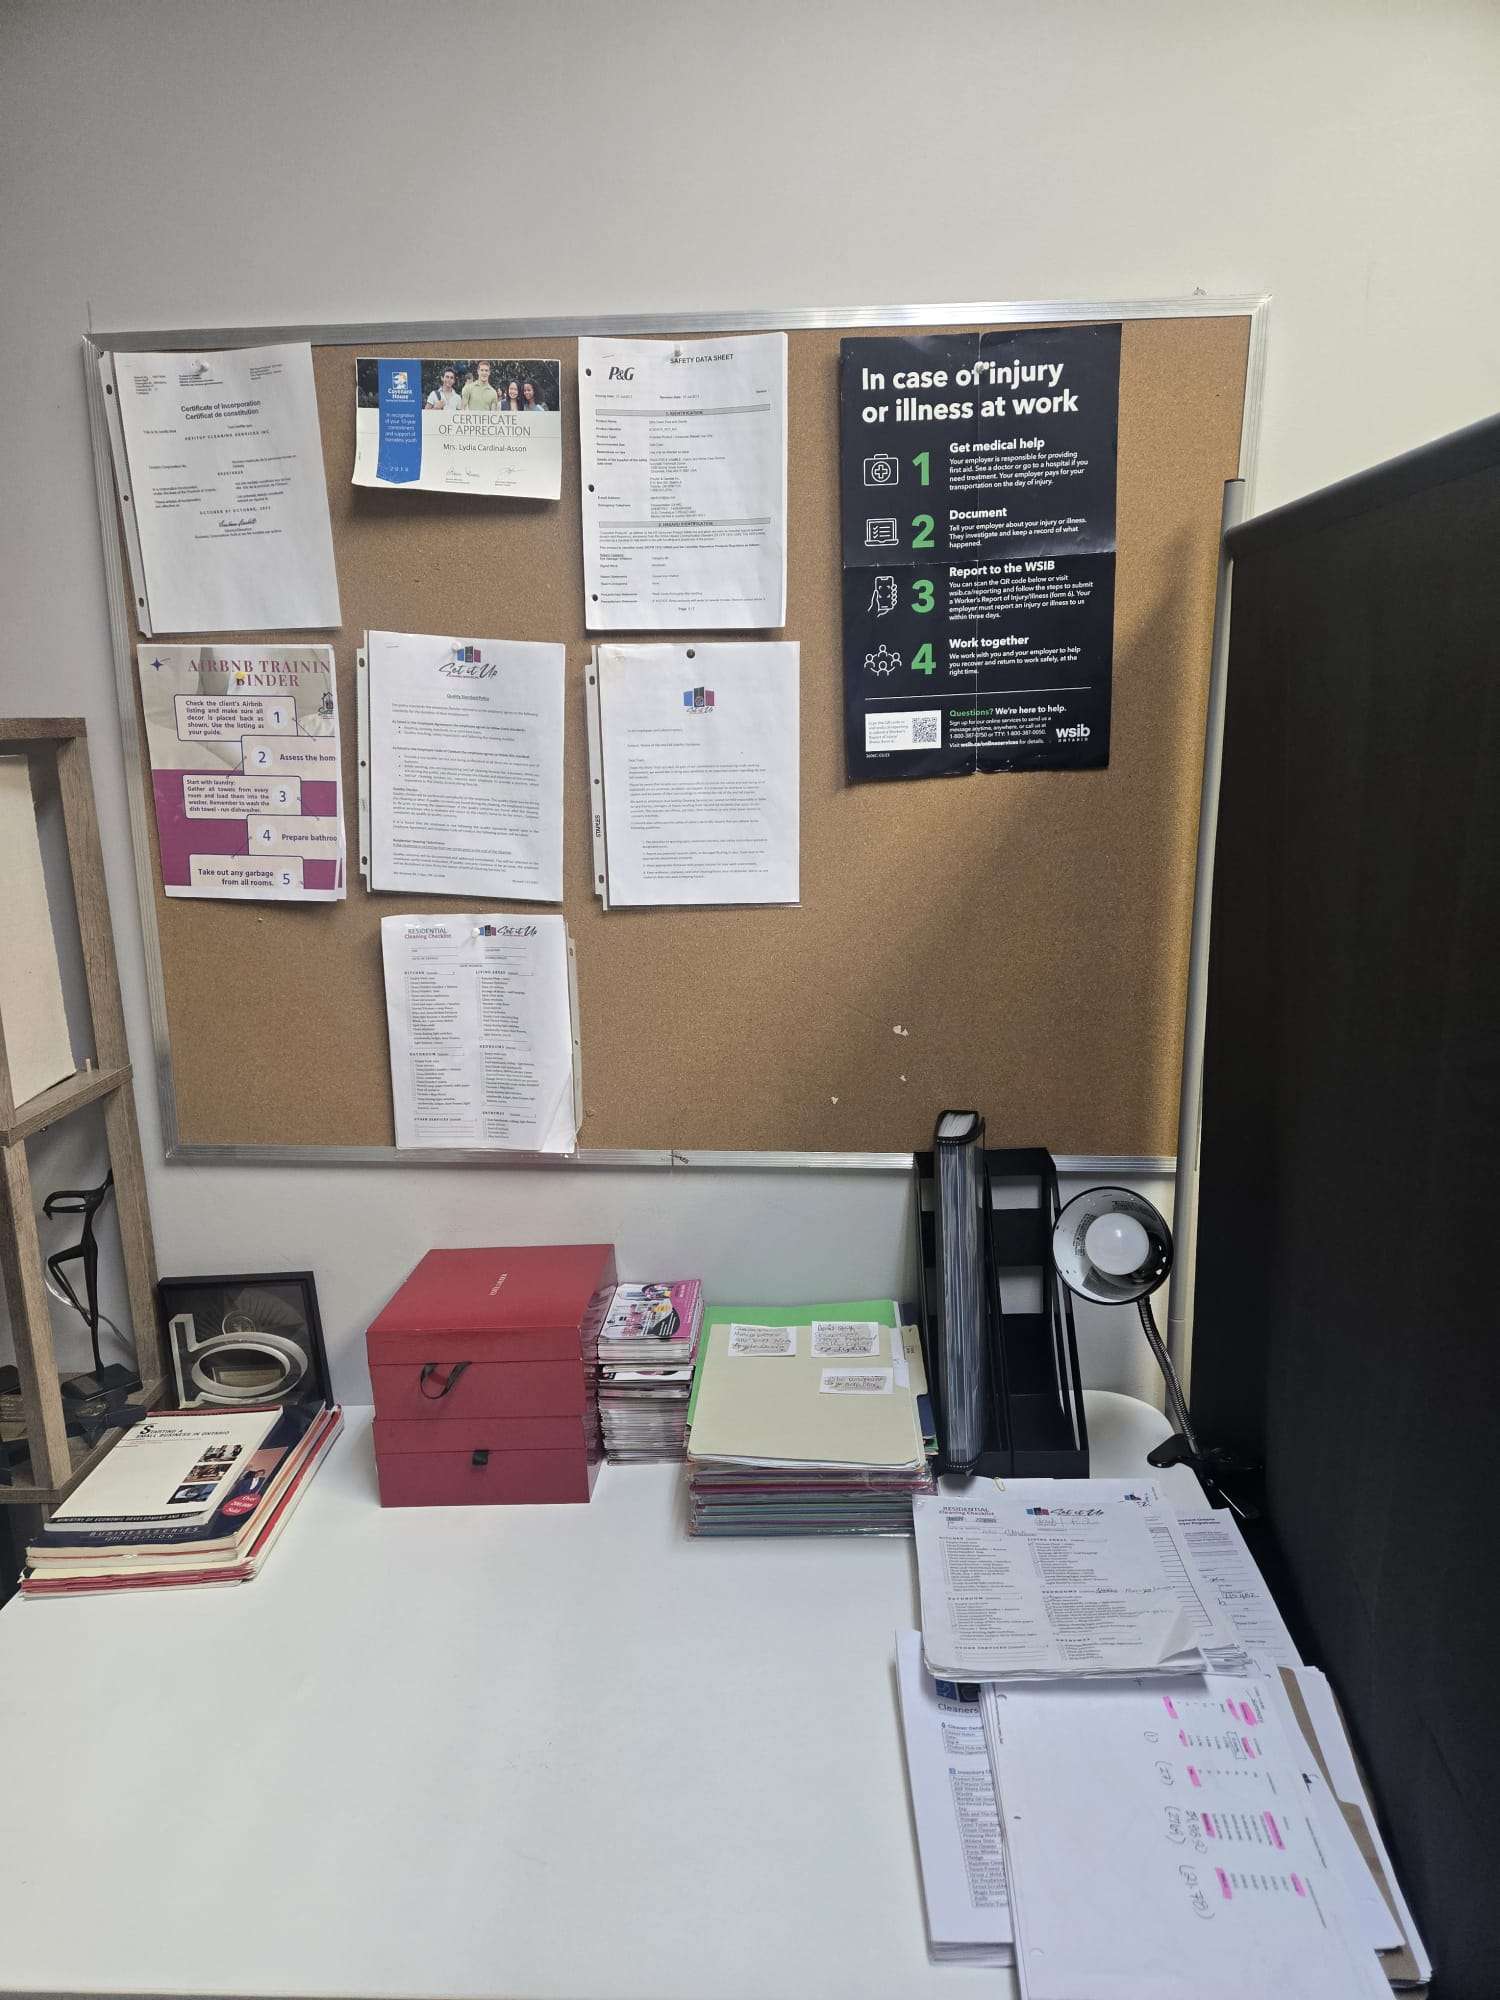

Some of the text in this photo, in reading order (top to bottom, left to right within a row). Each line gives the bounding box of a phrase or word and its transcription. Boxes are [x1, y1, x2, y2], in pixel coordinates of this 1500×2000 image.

[609, 366, 635, 381] P&G
[862, 359, 1064, 390] In case of injury
[862, 389, 1079, 423] or illness at work
[453, 414, 517, 425] CERTIFICATE
[439, 425, 531, 436] OF APPRECIATION
[478, 444, 526, 452] Cardinal-Asson
[950, 437, 1045, 453] Get medical help
[1001, 454, 1036, 462] responsible
[1048, 452, 1077, 460] providing
[912, 452, 930, 486] 1
[1046, 460, 1070, 468] hospital
[950, 483, 992, 491] transportation
[950, 507, 1007, 520] Document
[911, 514, 935, 548] 2
[950, 561, 1055, 578] Report to the WSIB
[912, 579, 934, 613] 3
[950, 636, 1029, 648] Work together
[912, 643, 936, 675] 4
[188, 660, 253, 673] AIRBNB
[467, 666, 477, 675] it
[236, 674, 299, 687] BINDER
[274, 711, 280, 723] 1
[950, 708, 993, 717] Questions?
[996, 707, 1017, 715] We're
[1048, 705, 1067, 713] help.
[1056, 724, 1090, 738] wsib
[258, 751, 266, 763] 2
[279, 791, 286, 802] 3
[263, 830, 271, 841] 4
[282, 834, 308, 842] Prepare
[245, 869, 273, 877] garbage
[282, 874, 290, 885] 5
[938, 1704, 978, 1713] Cleaners
